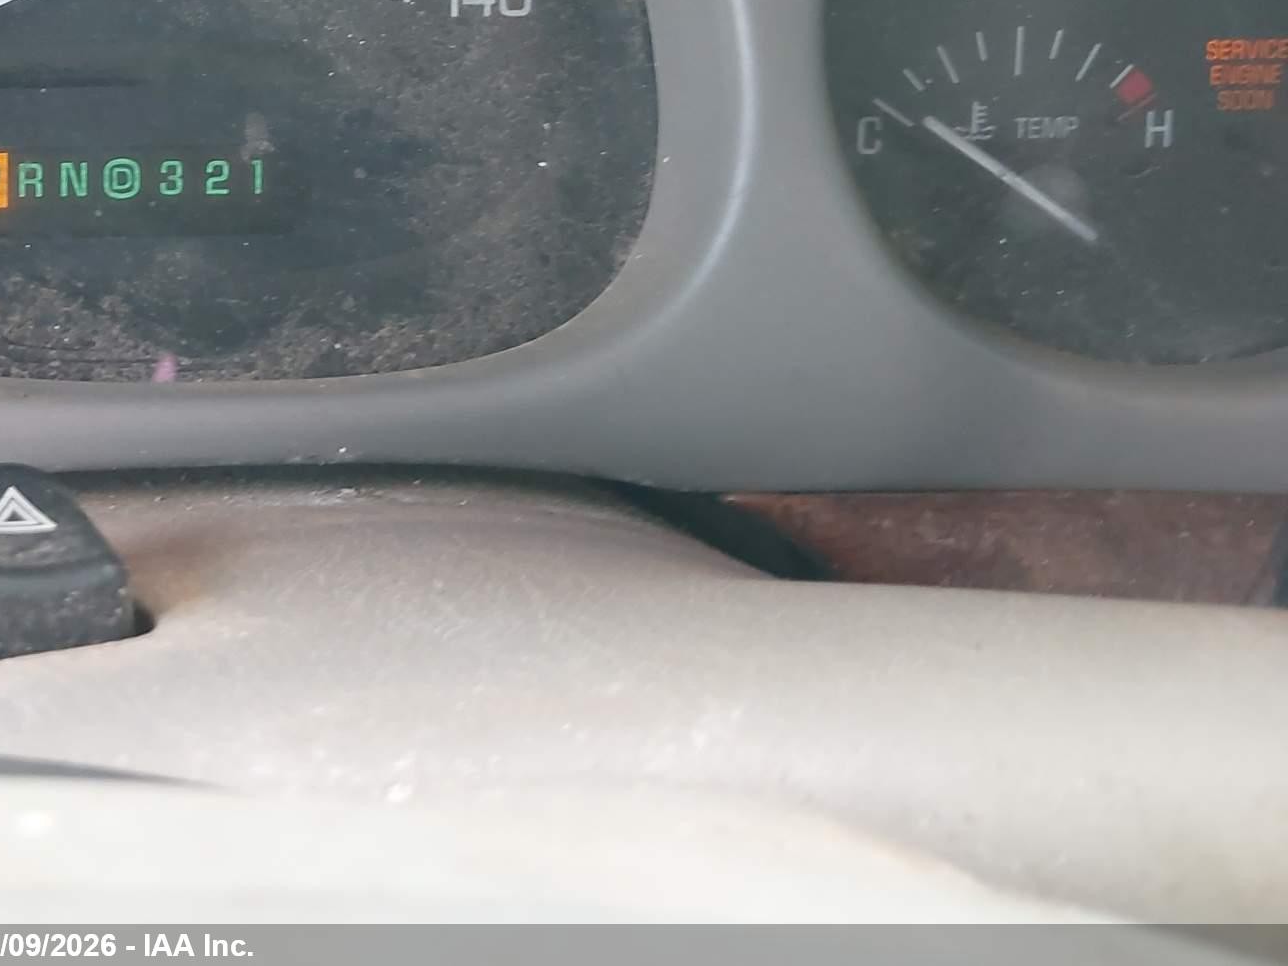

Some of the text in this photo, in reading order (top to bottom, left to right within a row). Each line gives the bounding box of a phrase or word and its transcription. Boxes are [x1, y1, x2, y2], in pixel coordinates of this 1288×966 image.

[1206, 38, 1288, 61] SERVICE
[1210, 64, 1281, 86] ENGINE
[1218, 88, 1274, 112] SOON
[856, 116, 883, 155] C
[1014, 116, 1079, 139] TEMP
[1145, 109, 1173, 148] H
[18, 161, 45, 198] R
[59, 161, 89, 198] N
[159, 159, 185, 198] 3
[203, 159, 231, 197] 2
[252, 158, 264, 193] 1
